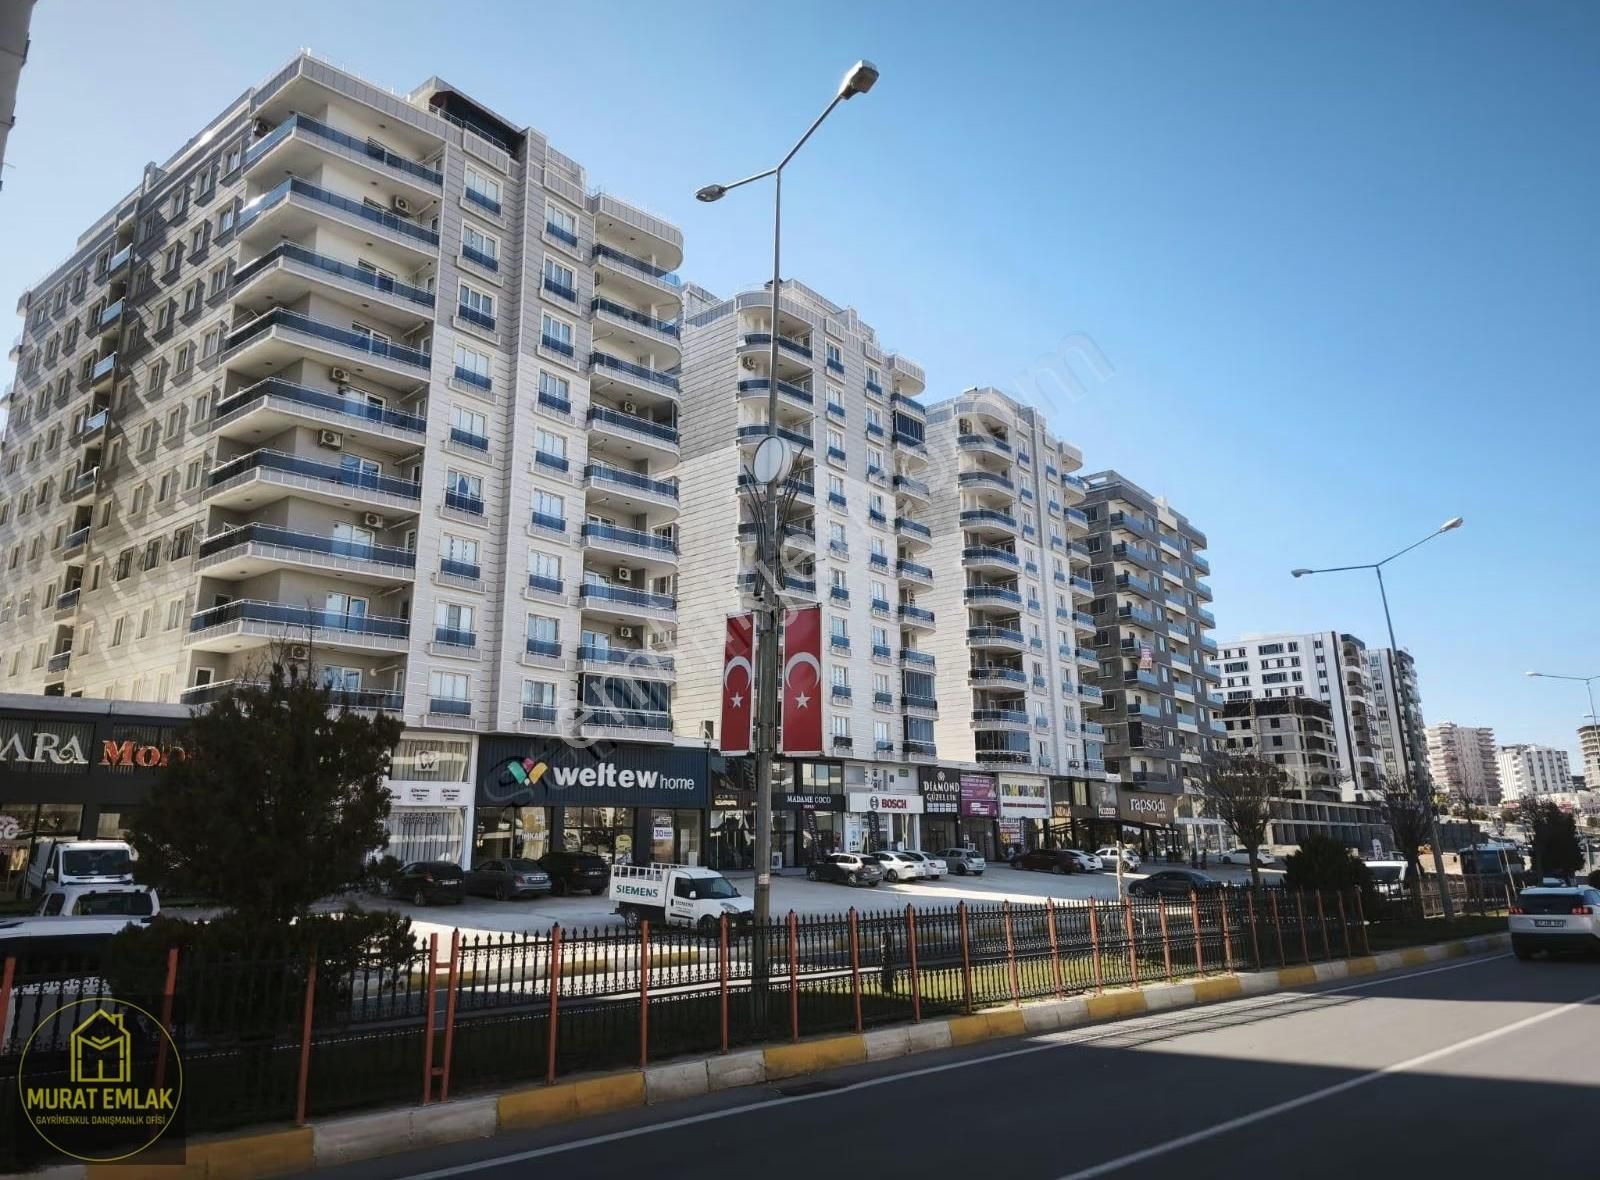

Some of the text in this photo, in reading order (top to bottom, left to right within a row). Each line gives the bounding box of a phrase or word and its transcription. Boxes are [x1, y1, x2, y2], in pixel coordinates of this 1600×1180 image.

[0, 732, 88, 764] ARA
[553, 762, 694, 790] weltew home
[923, 781, 960, 793] DIAMOND
[787, 795, 831, 804] MADAME COCO
[881, 798, 907, 809] BOSCH
[1129, 798, 1166, 813] rapsodi
[616, 884, 659, 898] SIEMENS
